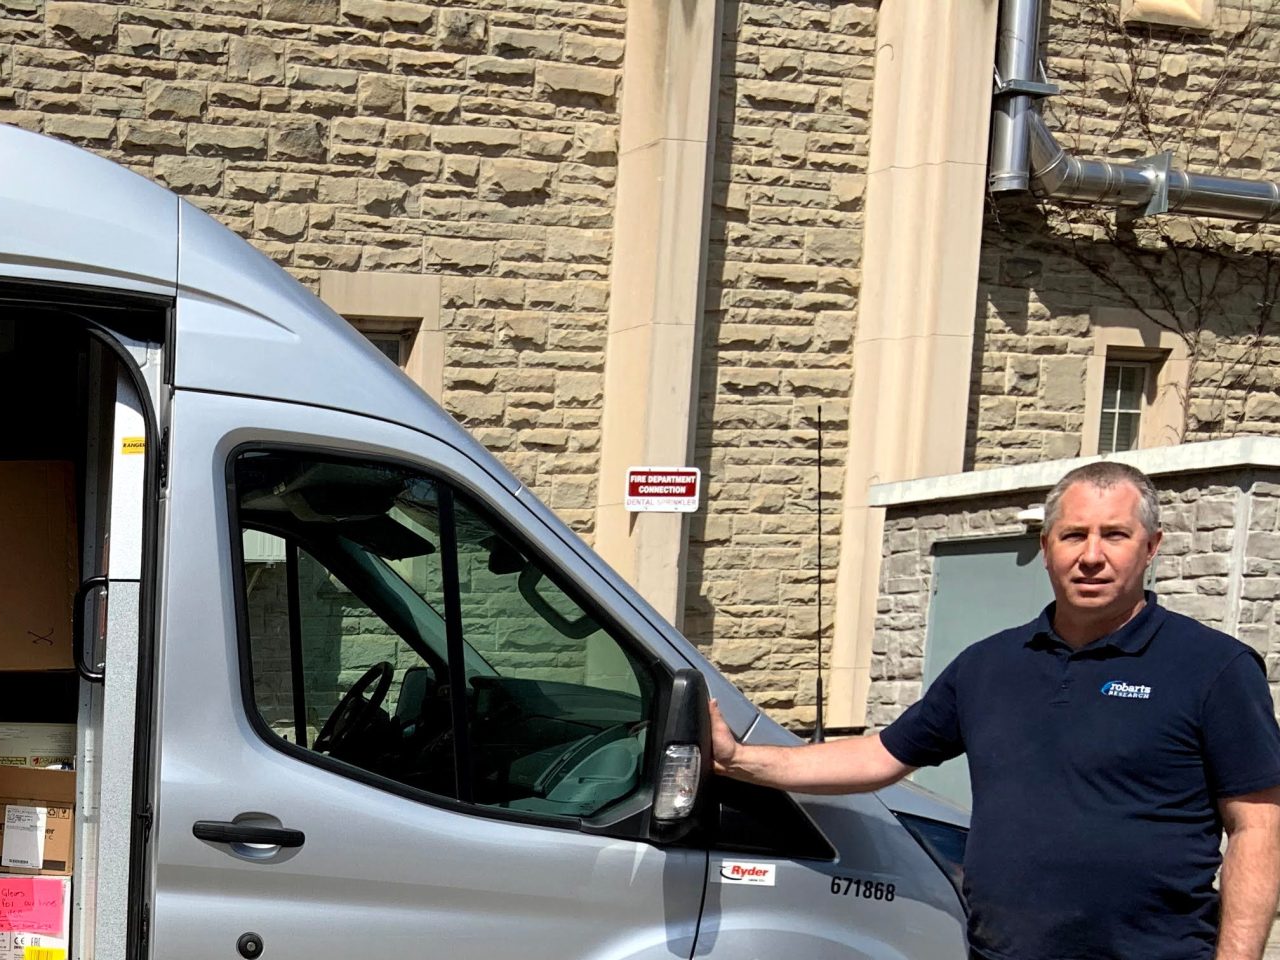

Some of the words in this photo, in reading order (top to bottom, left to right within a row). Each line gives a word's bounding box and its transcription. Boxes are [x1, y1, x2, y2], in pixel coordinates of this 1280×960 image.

[630, 475, 646, 483] FIRE
[648, 475, 696, 484] DEPARTMENT
[638, 486, 686, 494] CONNECTION
[627, 498, 654, 506] DENTAL
[657, 498, 697, 506] SPRINKLER
[1110, 683, 1151, 693] robarts
[1108, 690, 1150, 699] RESEARCH
[731, 865, 769, 878] Ryder
[830, 875, 896, 902] 671868
